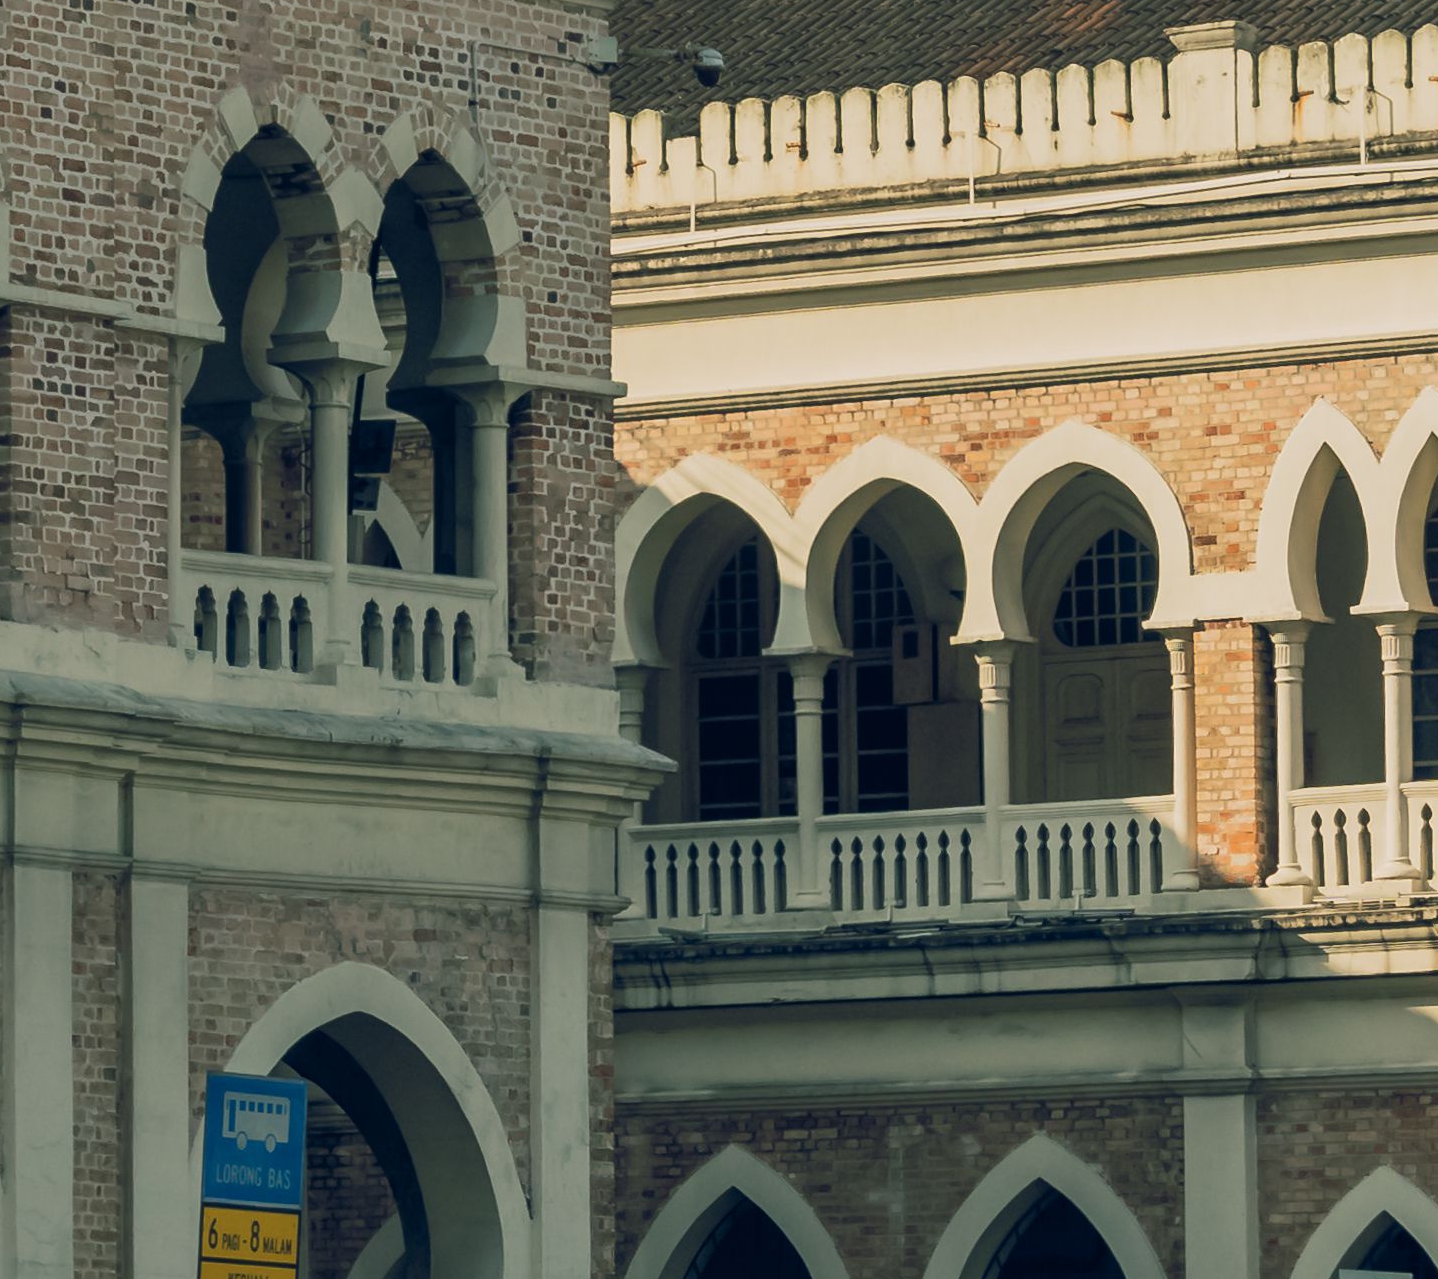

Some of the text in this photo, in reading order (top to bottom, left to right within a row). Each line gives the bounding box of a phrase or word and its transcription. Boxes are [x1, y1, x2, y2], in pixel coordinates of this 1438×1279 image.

[216, 1163, 290, 1190] LORONG BAS
[208, 1218, 218, 1249] 6
[222, 1234, 240, 1251] PAGI
[250, 1220, 260, 1253] 8
[263, 1237, 292, 1255] MALAM
